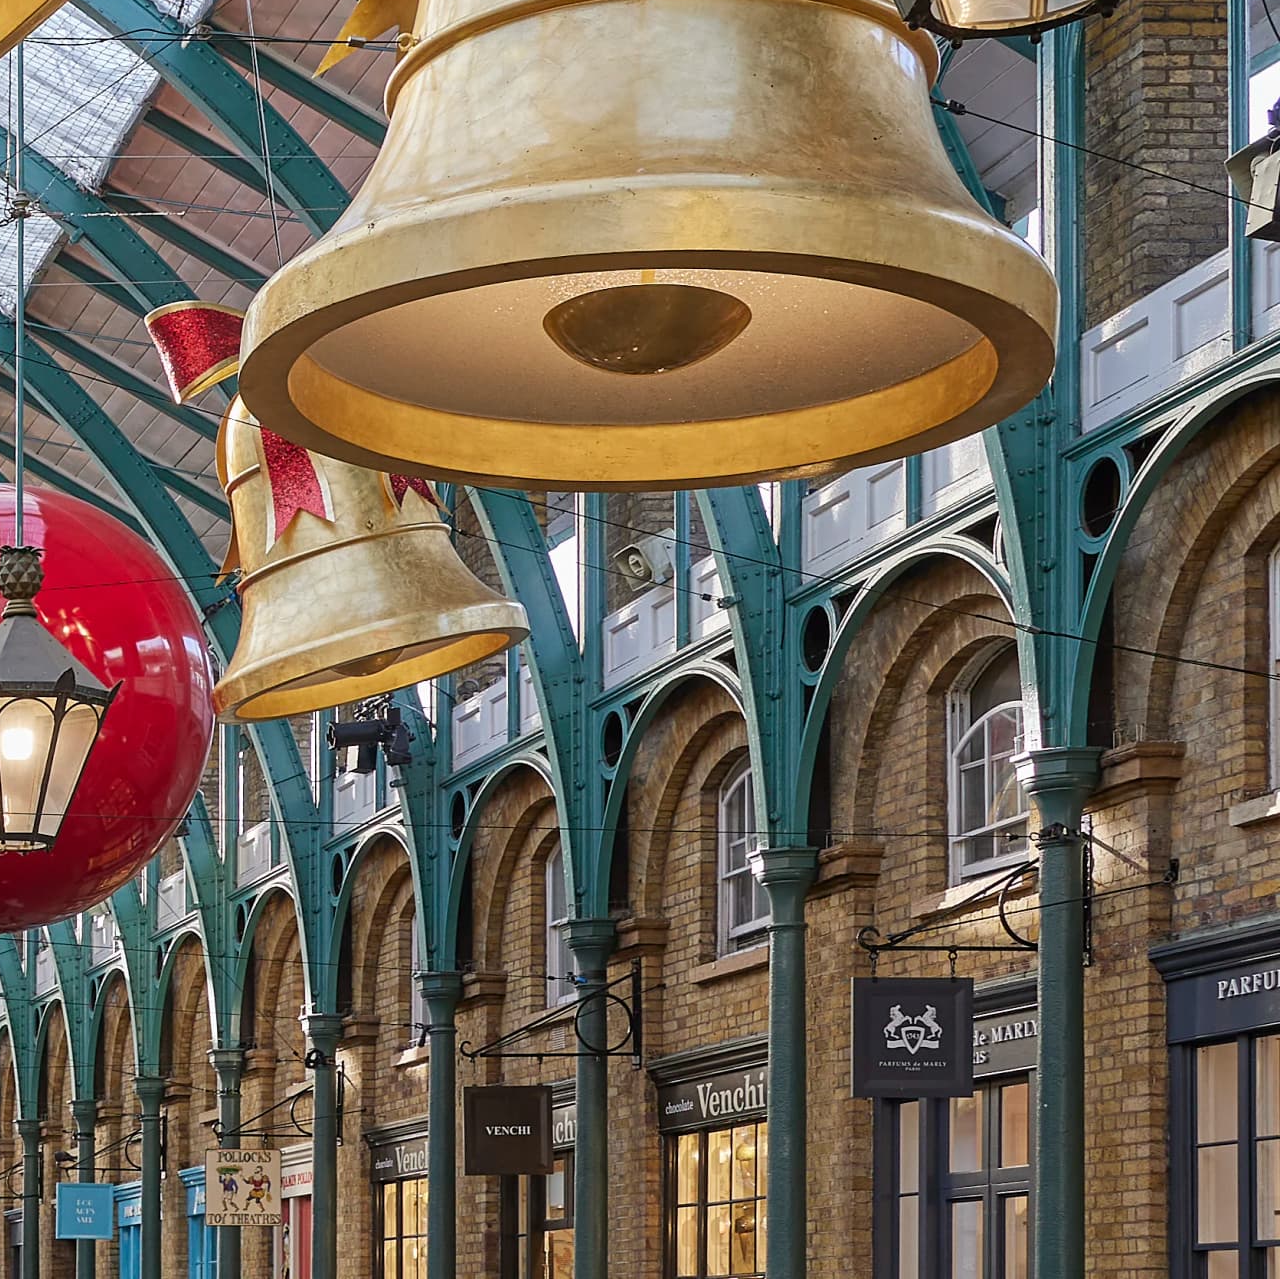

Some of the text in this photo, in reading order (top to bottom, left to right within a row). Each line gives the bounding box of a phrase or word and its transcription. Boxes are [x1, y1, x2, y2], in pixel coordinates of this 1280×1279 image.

[1217, 969, 1280, 999] PARFU
[991, 1019, 1039, 1044] MARLY
[665, 1072, 766, 1119] chocolate Venchi
[485, 1125, 531, 1136] VENCHI
[207, 1213, 281, 1225] TOY THEATRES
